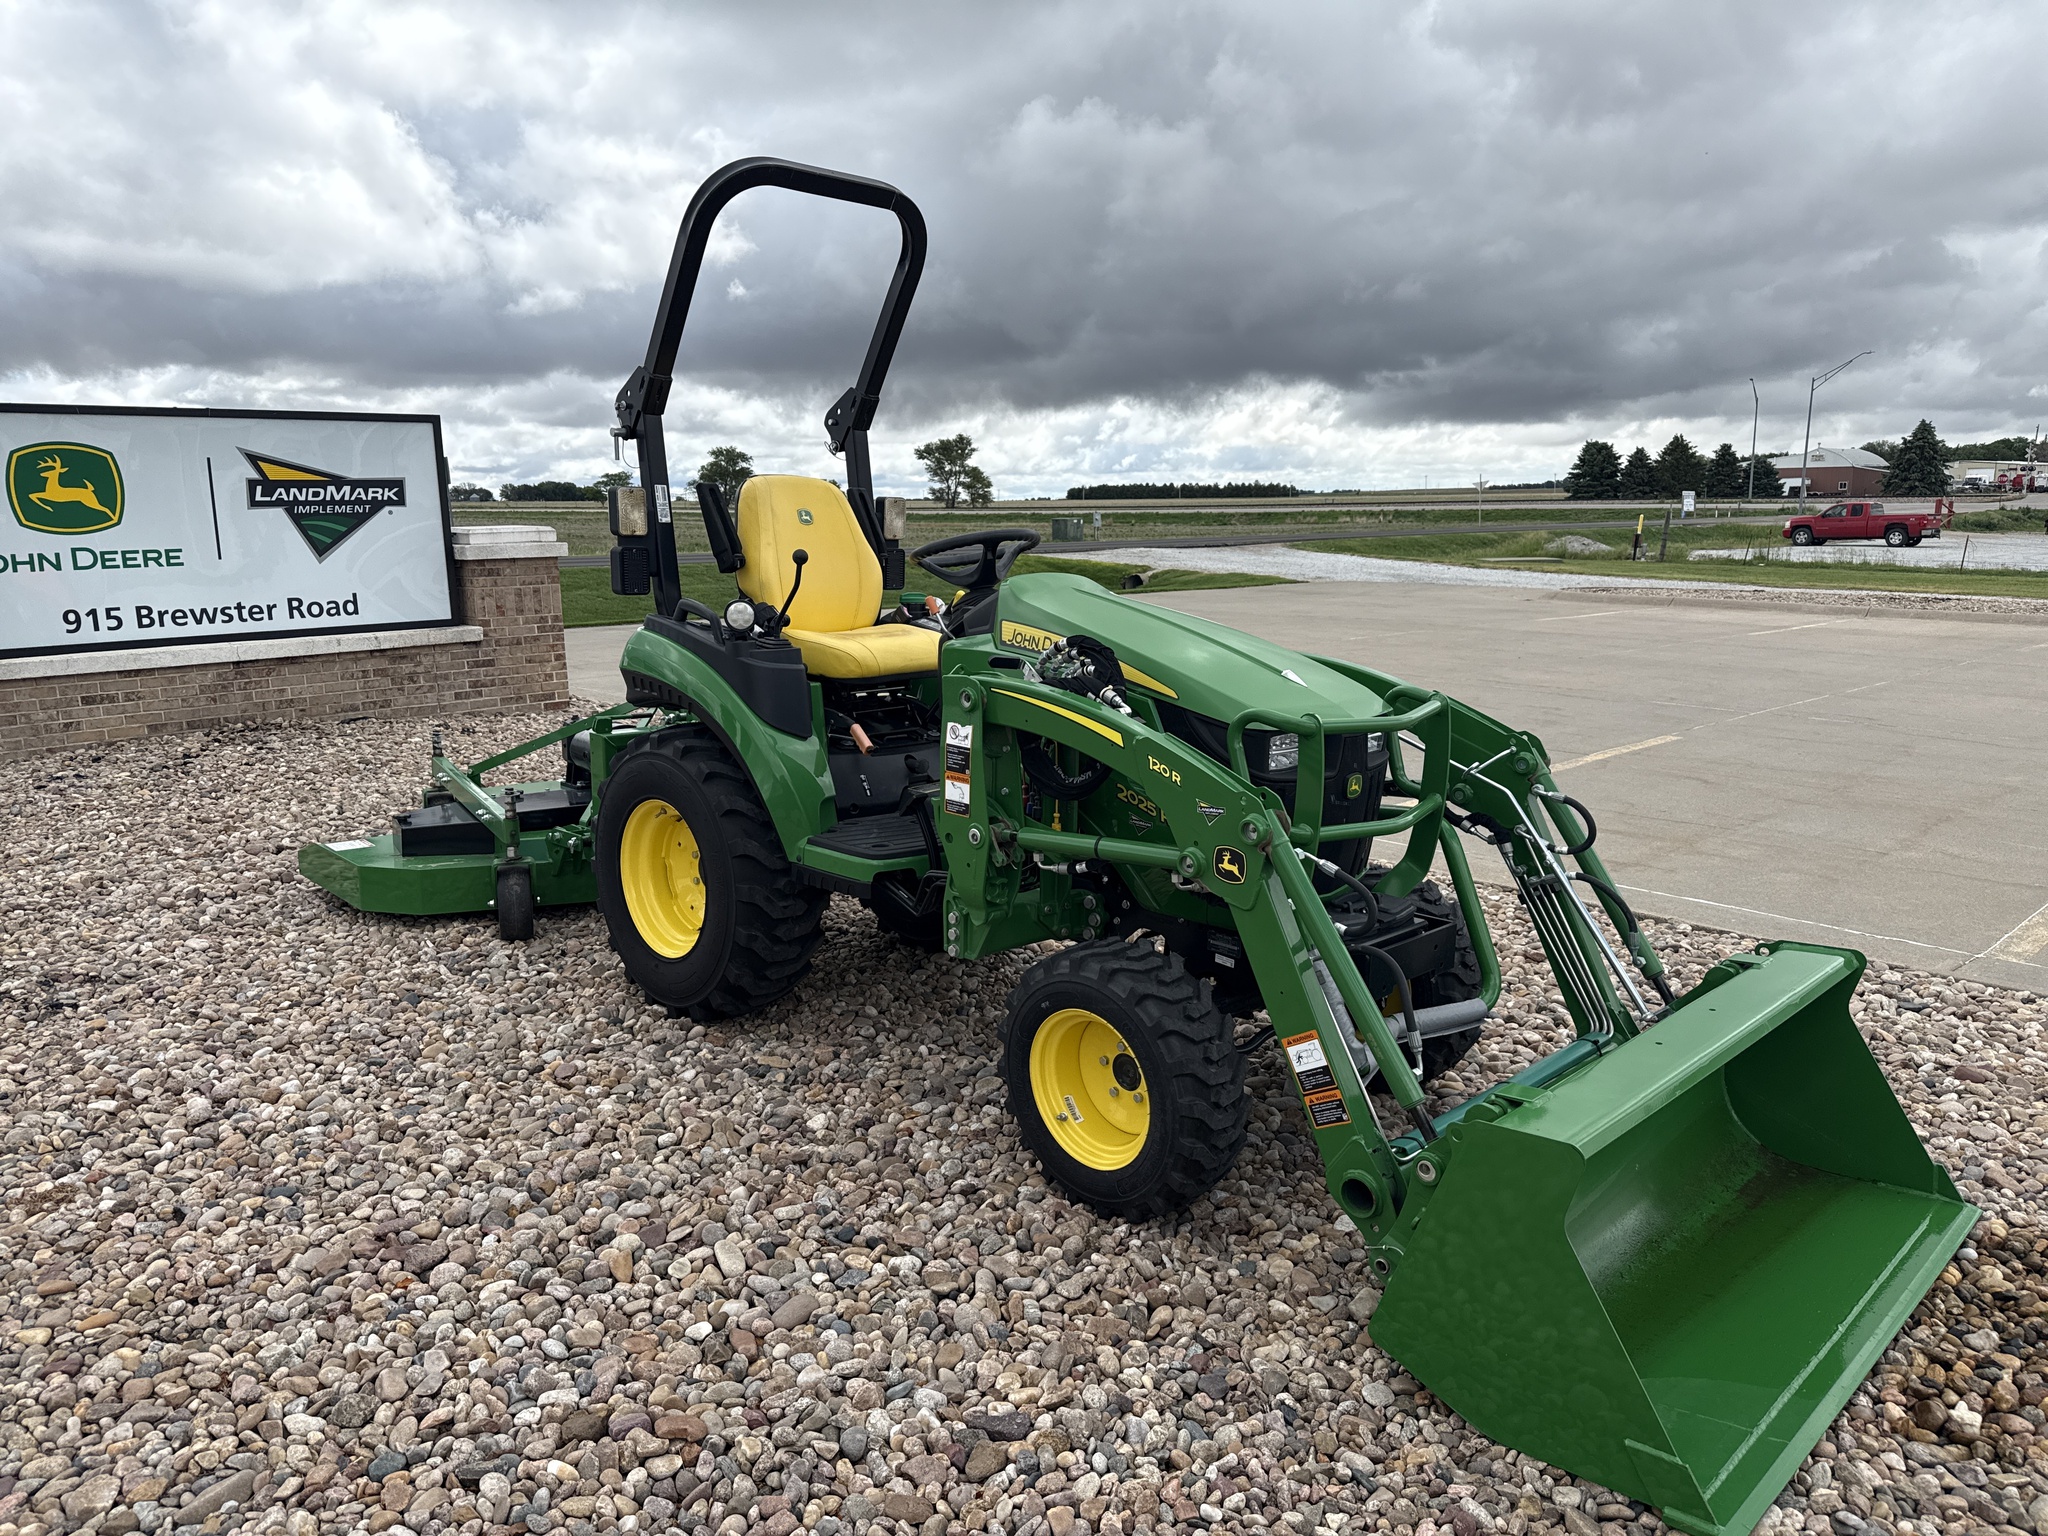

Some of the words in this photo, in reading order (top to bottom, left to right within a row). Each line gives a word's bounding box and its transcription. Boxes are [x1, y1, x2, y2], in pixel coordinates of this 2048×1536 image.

[254, 485, 399, 501] LANDMARK
[294, 505, 371, 514] IMPLEMENT
[70, 547, 185, 571] DEERE
[62, 606, 124, 634] 915
[135, 601, 277, 629] Brewster
[286, 592, 359, 620] Road
[1007, 628, 1040, 649] JOHN
[1147, 755, 1170, 778] 120
[1171, 770, 1182, 787] R
[1116, 783, 1157, 817] 2025
[1292, 1033, 1314, 1043] WARNING
[1315, 1093, 1338, 1103] WARNING
